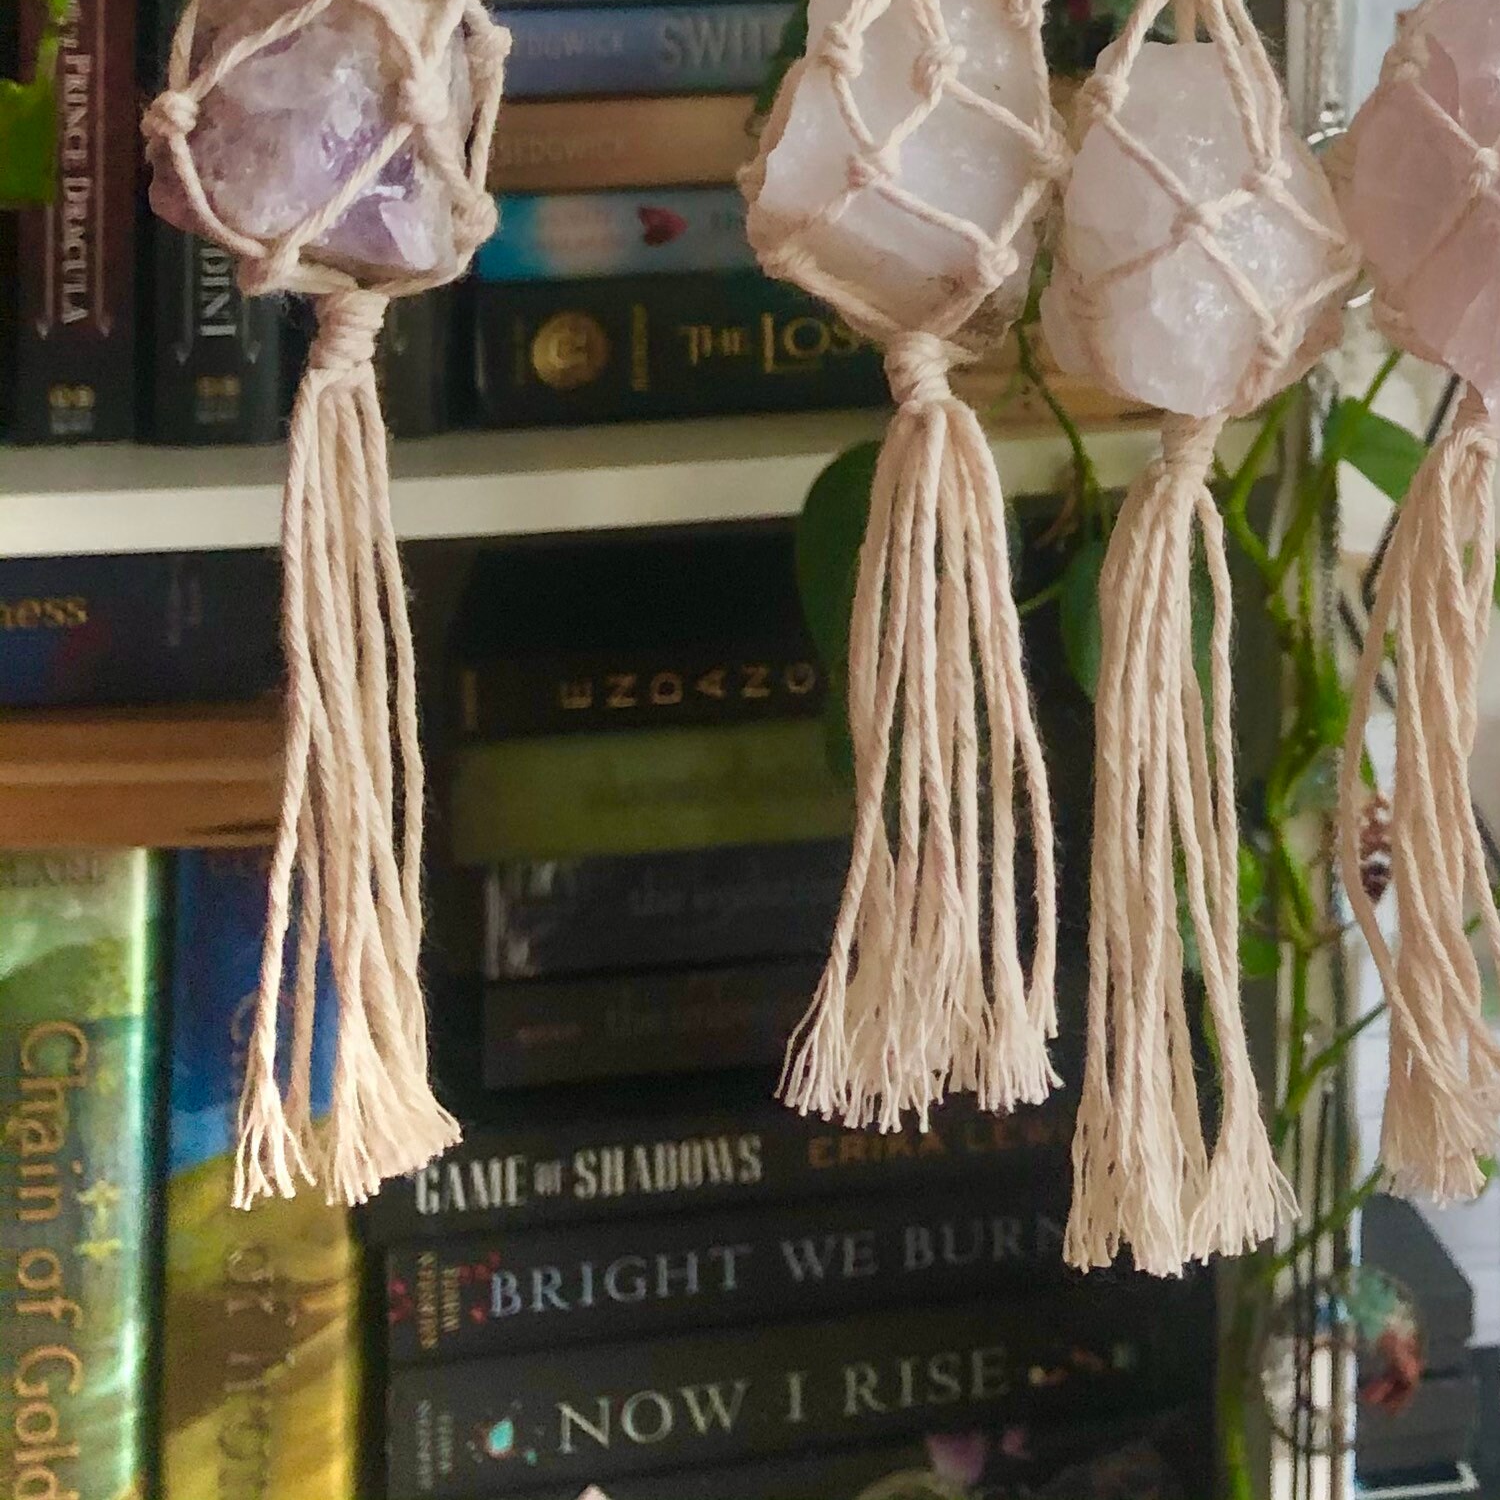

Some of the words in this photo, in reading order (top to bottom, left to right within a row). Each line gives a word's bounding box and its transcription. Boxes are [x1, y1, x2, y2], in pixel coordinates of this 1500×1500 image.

[61, 53, 92, 166] PRINCE
[60, 175, 92, 327] DRACULA
[200, 243, 236, 338] DINI
[761, 311, 864, 375] LOS
[19, 1020, 88, 1222] Chain
[414, 1153, 528, 1216] GAME
[573, 1133, 765, 1200] SHADOWS
[17, 1247, 83, 1331] of
[490, 1242, 754, 1319] BRIGHT
[778, 1228, 879, 1283] WE
[903, 1213, 1067, 1273] BURN
[556, 1377, 753, 1456] NOW
[783, 1367, 808, 1424] I
[842, 1345, 1010, 1419] RISE
